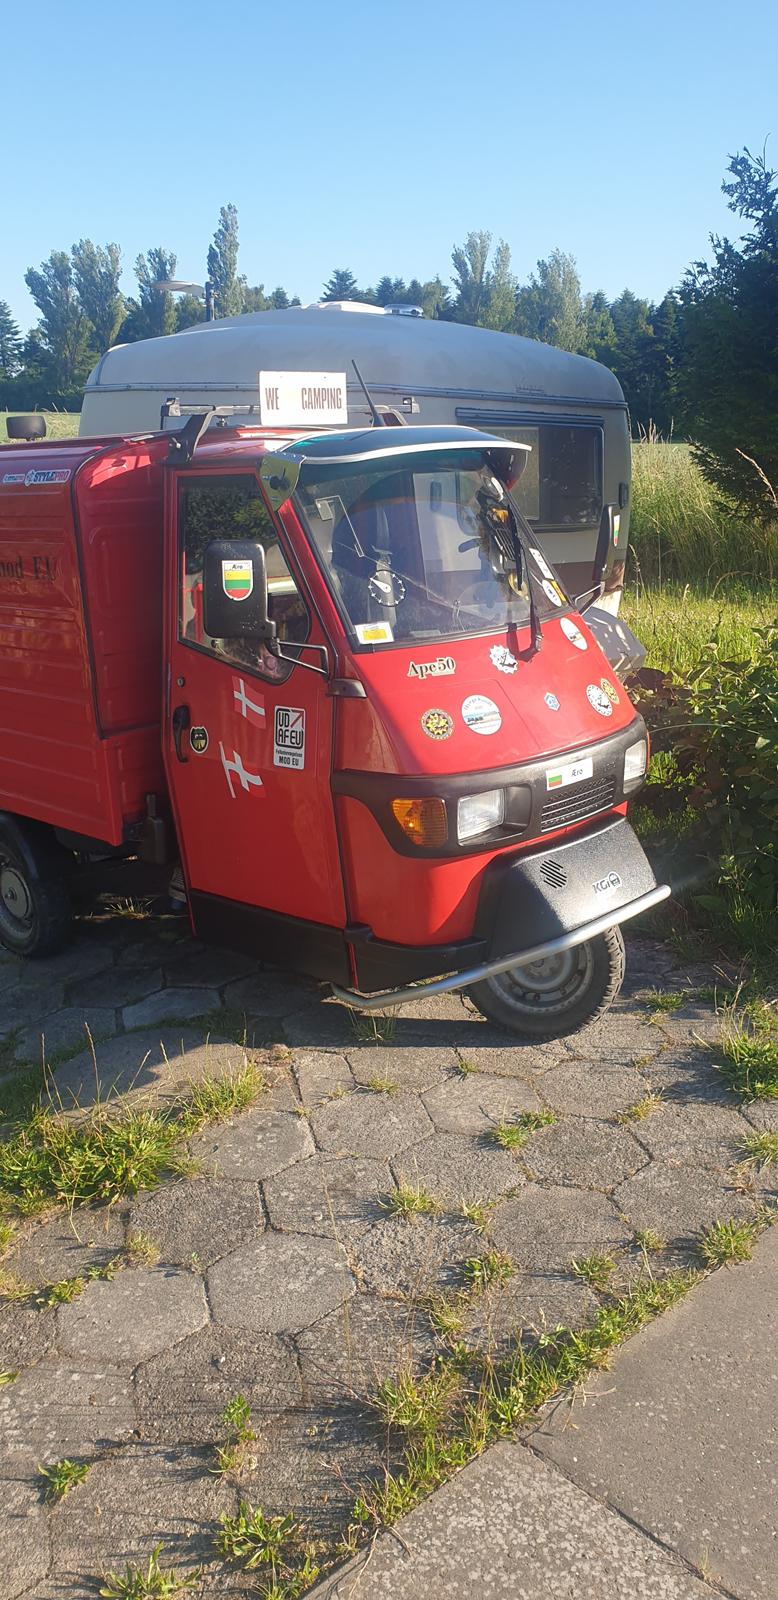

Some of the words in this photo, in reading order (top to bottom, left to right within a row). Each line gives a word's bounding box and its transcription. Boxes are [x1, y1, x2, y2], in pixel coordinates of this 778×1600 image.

[265, 387, 280, 410] WE
[301, 387, 342, 410] CAMPING
[278, 711, 290, 728] UD
[278, 755, 291, 765] MOD
[291, 757, 300, 767] EU
